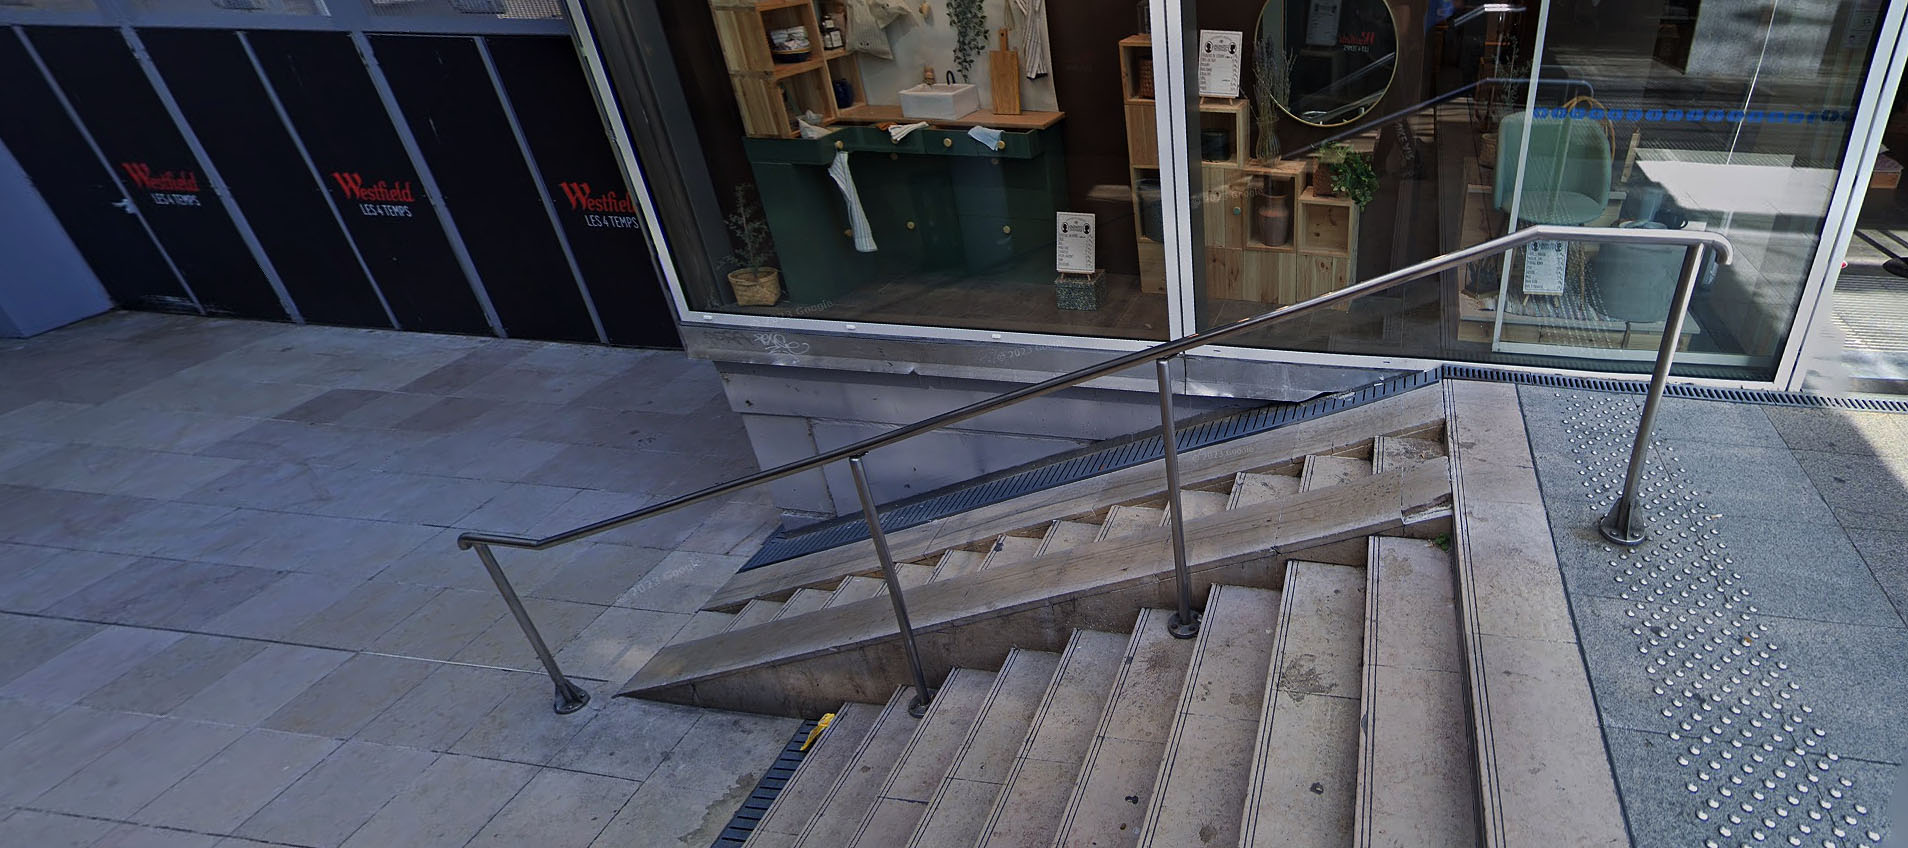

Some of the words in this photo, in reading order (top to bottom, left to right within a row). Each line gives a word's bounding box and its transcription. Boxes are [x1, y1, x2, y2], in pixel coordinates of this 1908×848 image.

[122, 163, 199, 192] Westfield
[333, 172, 415, 202] Westfield
[360, 204, 377, 215] LES
[381, 205, 412, 217] TEMPS
[584, 215, 602, 227] LES
[602, 215, 609, 227] 4
[608, 216, 639, 229] TEMPS
